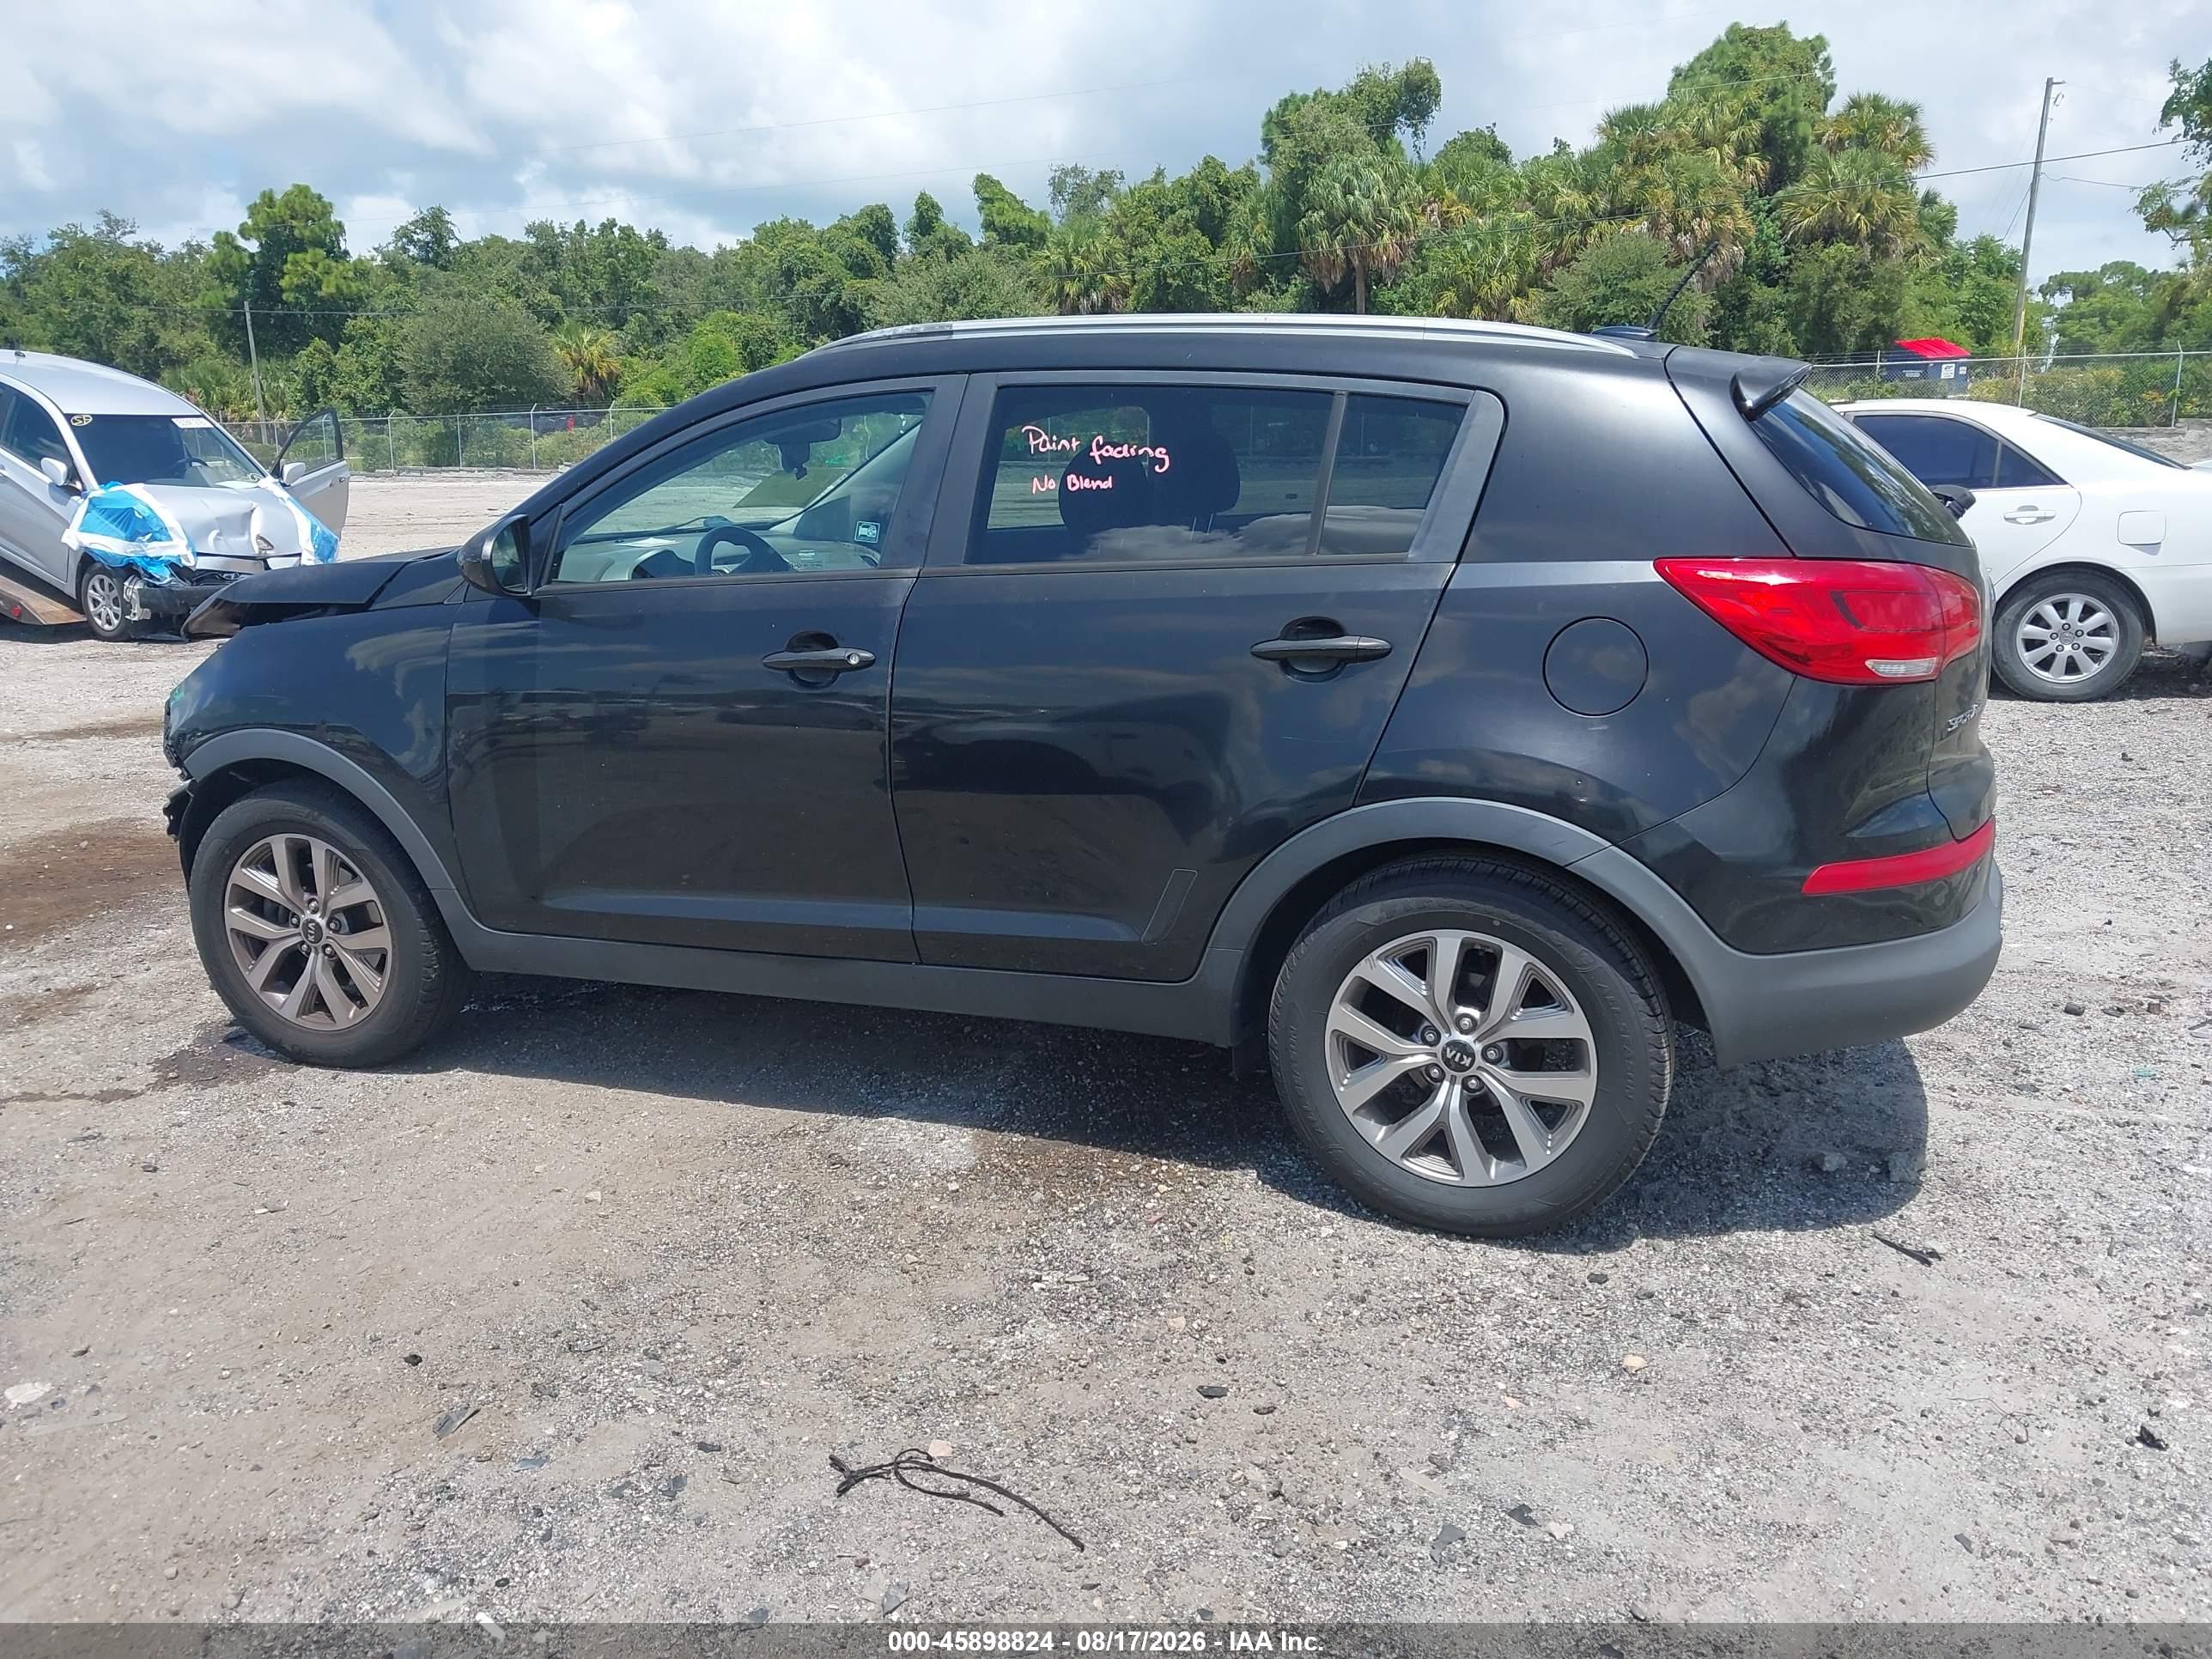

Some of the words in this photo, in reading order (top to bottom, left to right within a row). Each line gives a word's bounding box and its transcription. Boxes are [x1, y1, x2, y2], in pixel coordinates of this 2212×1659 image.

[1021, 425, 1081, 455] Paint
[1089, 434, 1170, 473] fading
[1031, 474, 1057, 495] No
[1066, 473, 1113, 492] Blend
[1446, 1047, 1473, 1067] KIA
